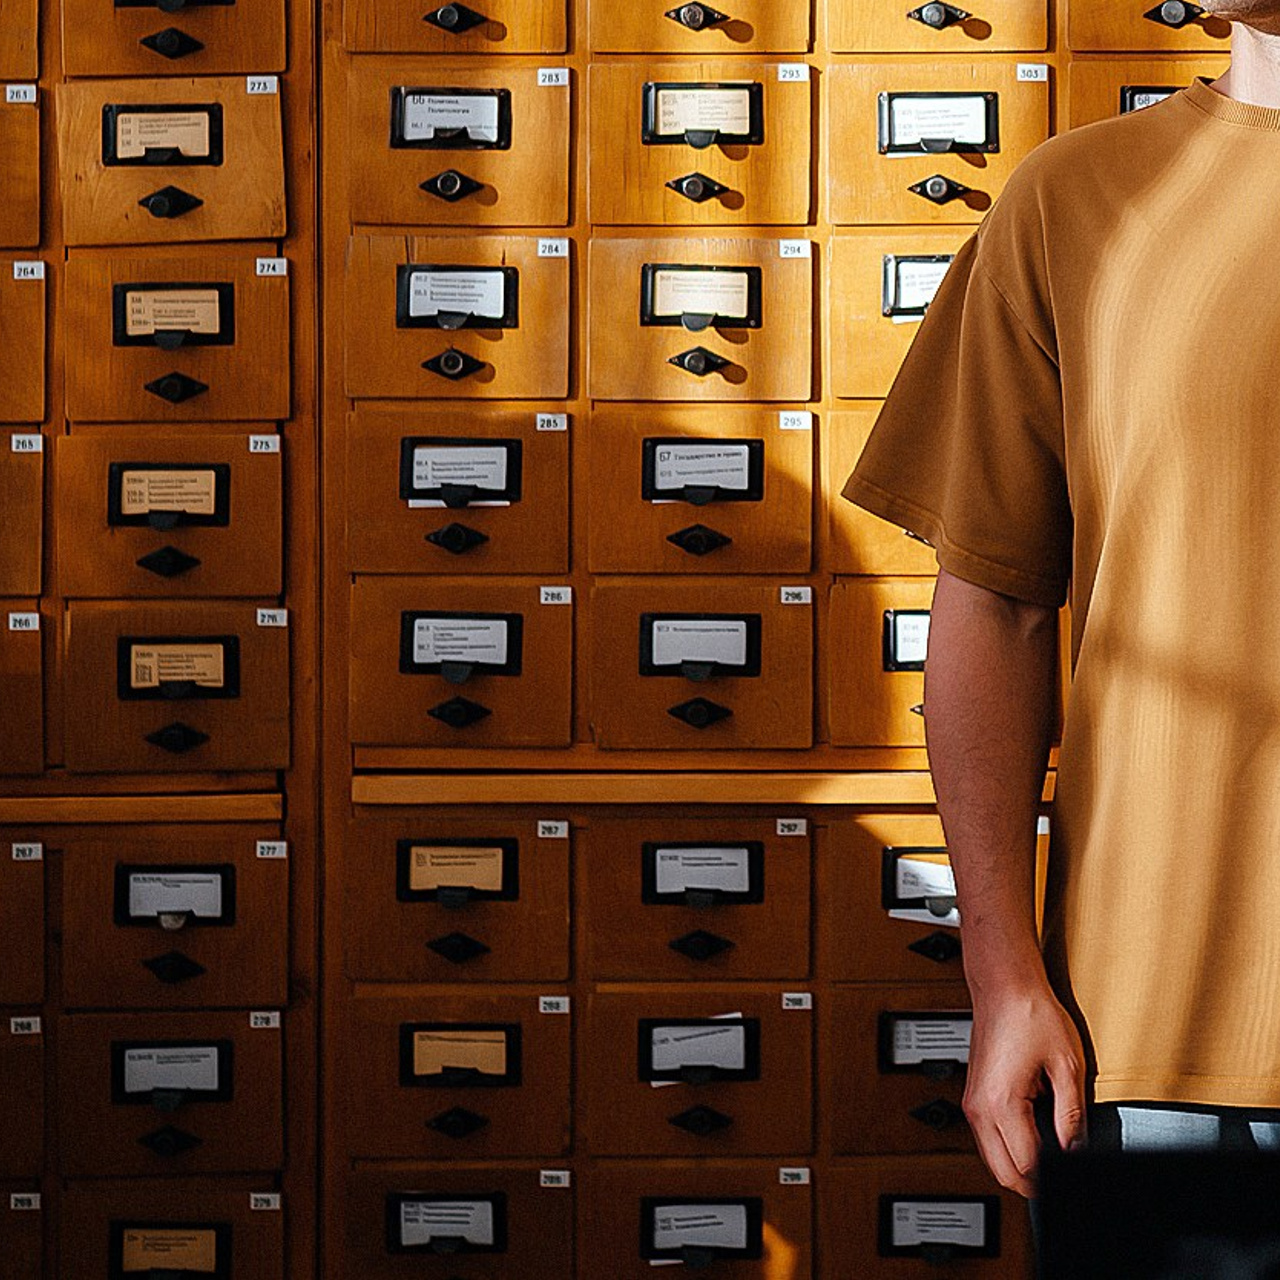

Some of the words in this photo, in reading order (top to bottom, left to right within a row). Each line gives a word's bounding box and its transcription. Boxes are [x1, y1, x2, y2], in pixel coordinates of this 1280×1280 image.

[541, 72, 560, 84] 283
[781, 68, 801, 79] 293
[1020, 69, 1039, 80] 303
[250, 81, 268, 92] 273
[9, 89, 28, 100] 263
[541, 243, 560, 254] 284
[782, 245, 802, 256] 294
[17, 266, 35, 277] 264
[259, 263, 277, 274] 274
[540, 418, 559, 429] 285
[783, 416, 802, 427] 295
[15, 439, 34, 450] 265
[253, 439, 271, 450] 275
[544, 591, 563, 602] 286
[12, 617, 31, 629] 266
